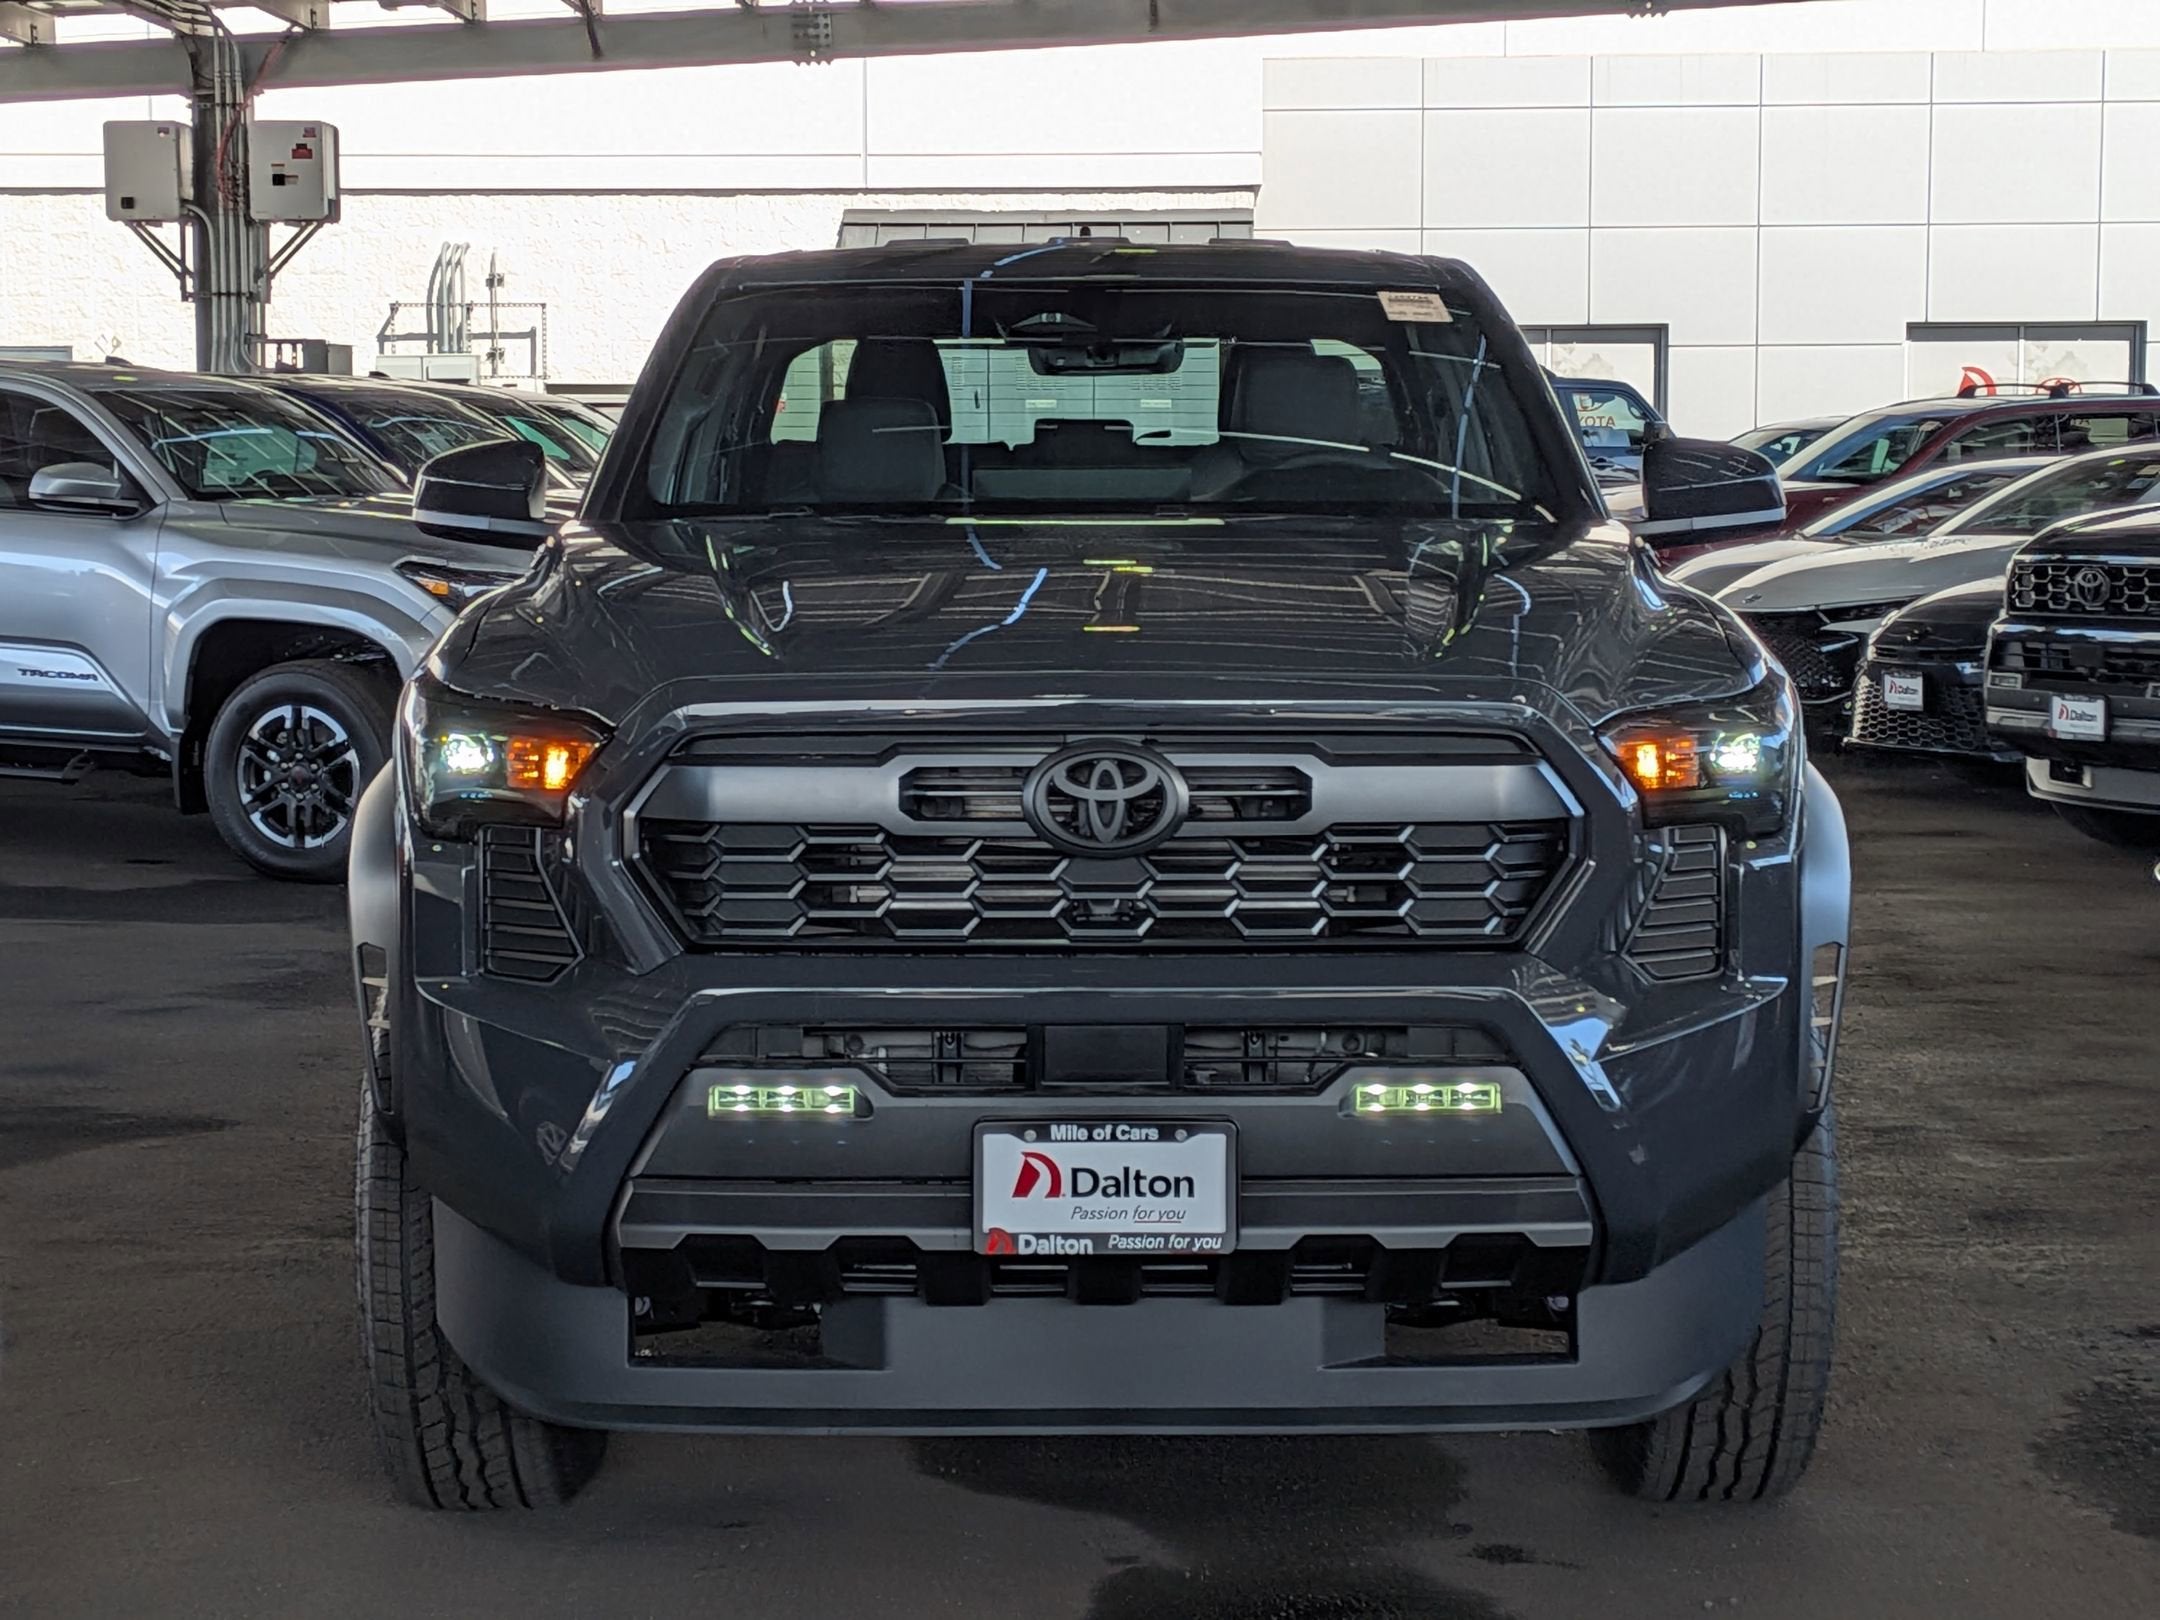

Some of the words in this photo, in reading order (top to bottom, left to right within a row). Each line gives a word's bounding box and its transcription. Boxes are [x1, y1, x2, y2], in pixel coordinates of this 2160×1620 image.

[17, 668, 98, 681] TACOMA
[1050, 1124, 1088, 1141] Mile
[1092, 1124, 1113, 1141] of
[1115, 1124, 1159, 1141] Cars
[1071, 1166, 1195, 1199] Dalton
[1071, 1206, 1128, 1220] Passion
[1133, 1205, 1155, 1220] for
[1158, 1210, 1186, 1223] you
[1018, 1234, 1094, 1255] Dalton
[1108, 1234, 1165, 1250] Passion
[1168, 1234, 1190, 1249] for
[1193, 1236, 1222, 1252] you
